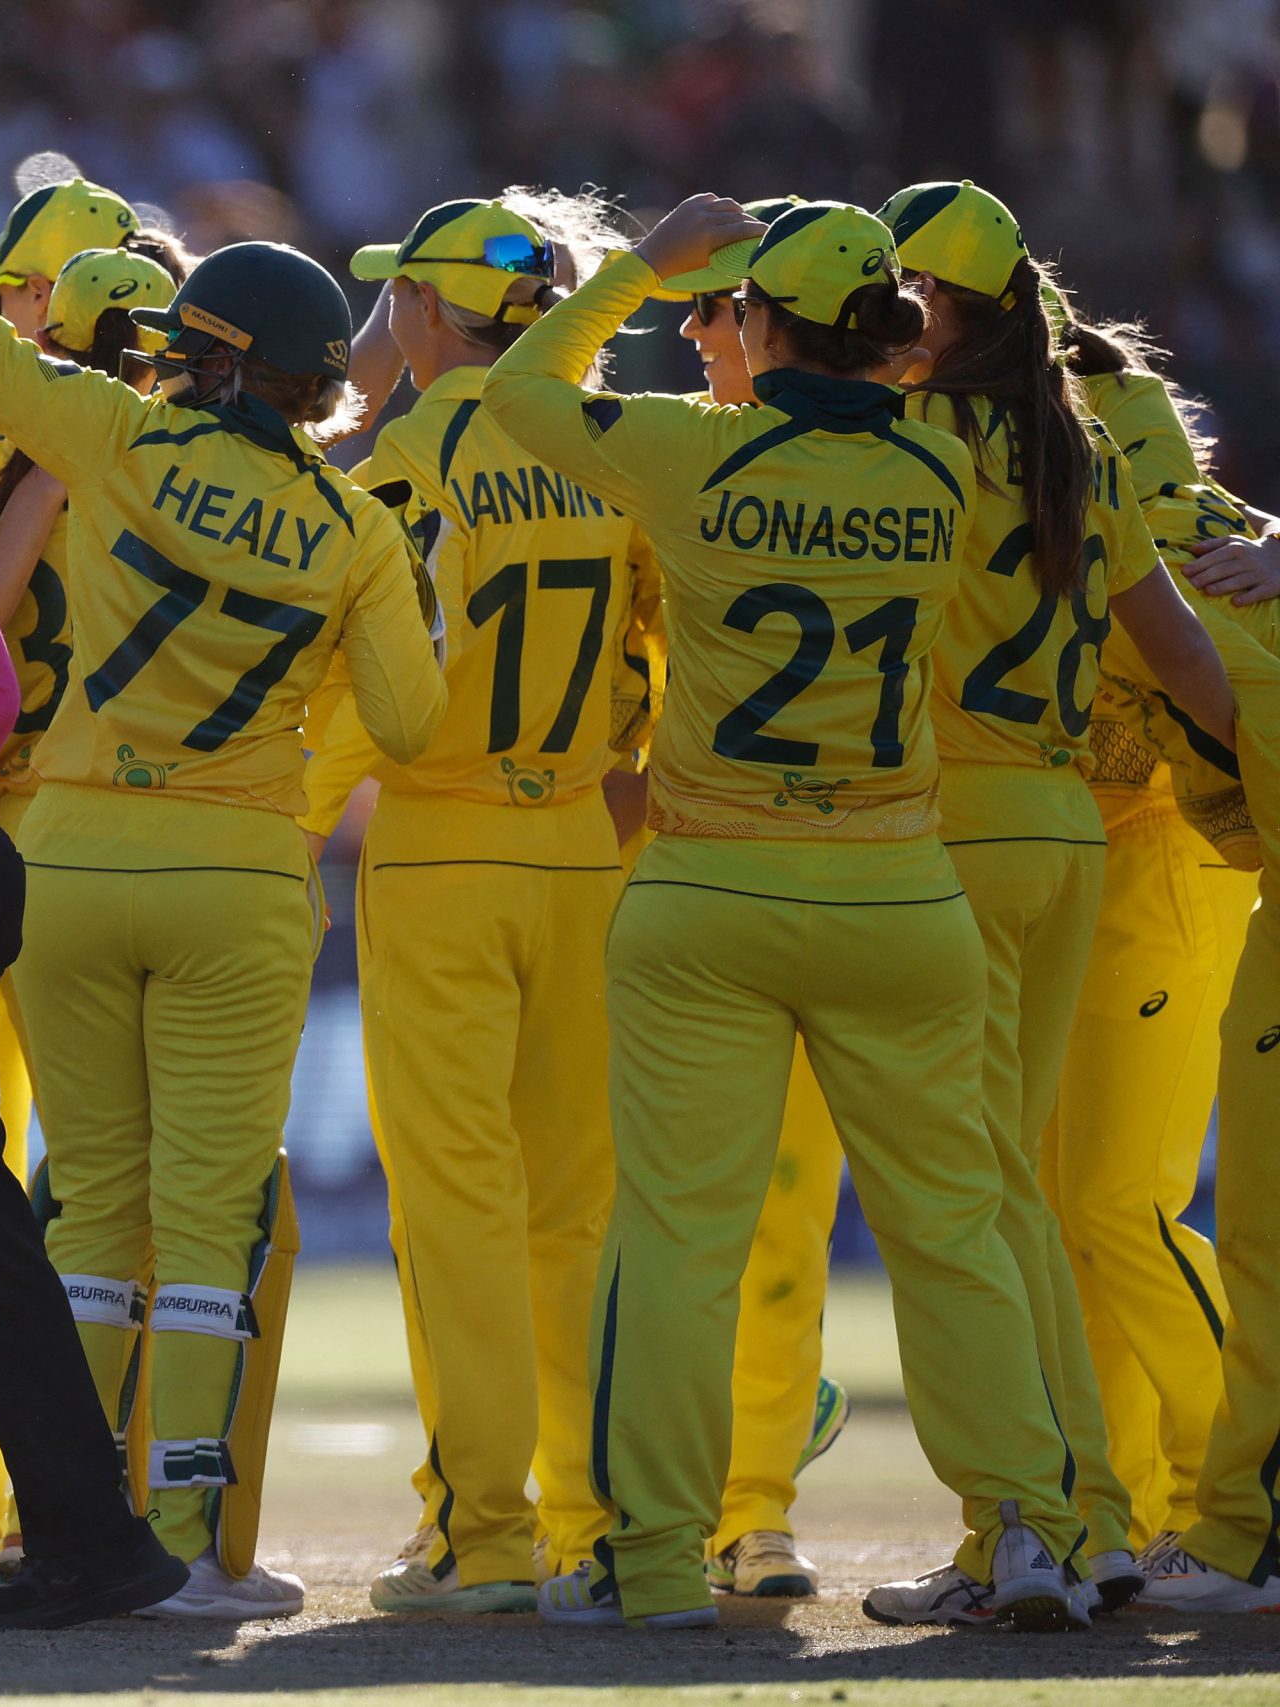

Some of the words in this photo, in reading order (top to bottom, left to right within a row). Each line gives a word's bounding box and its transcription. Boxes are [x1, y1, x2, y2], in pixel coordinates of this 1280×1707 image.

[191, 310, 228, 334] MASURI
[152, 464, 332, 572] HEALY
[450, 465, 624, 529] LANNIN
[699, 489, 955, 563] JONASSEN
[84, 528, 327, 753] 77
[466, 556, 612, 754] 17
[711, 582, 918, 768] 21
[959, 521, 1112, 738] 28
[64, 1285, 126, 1308] BURRA
